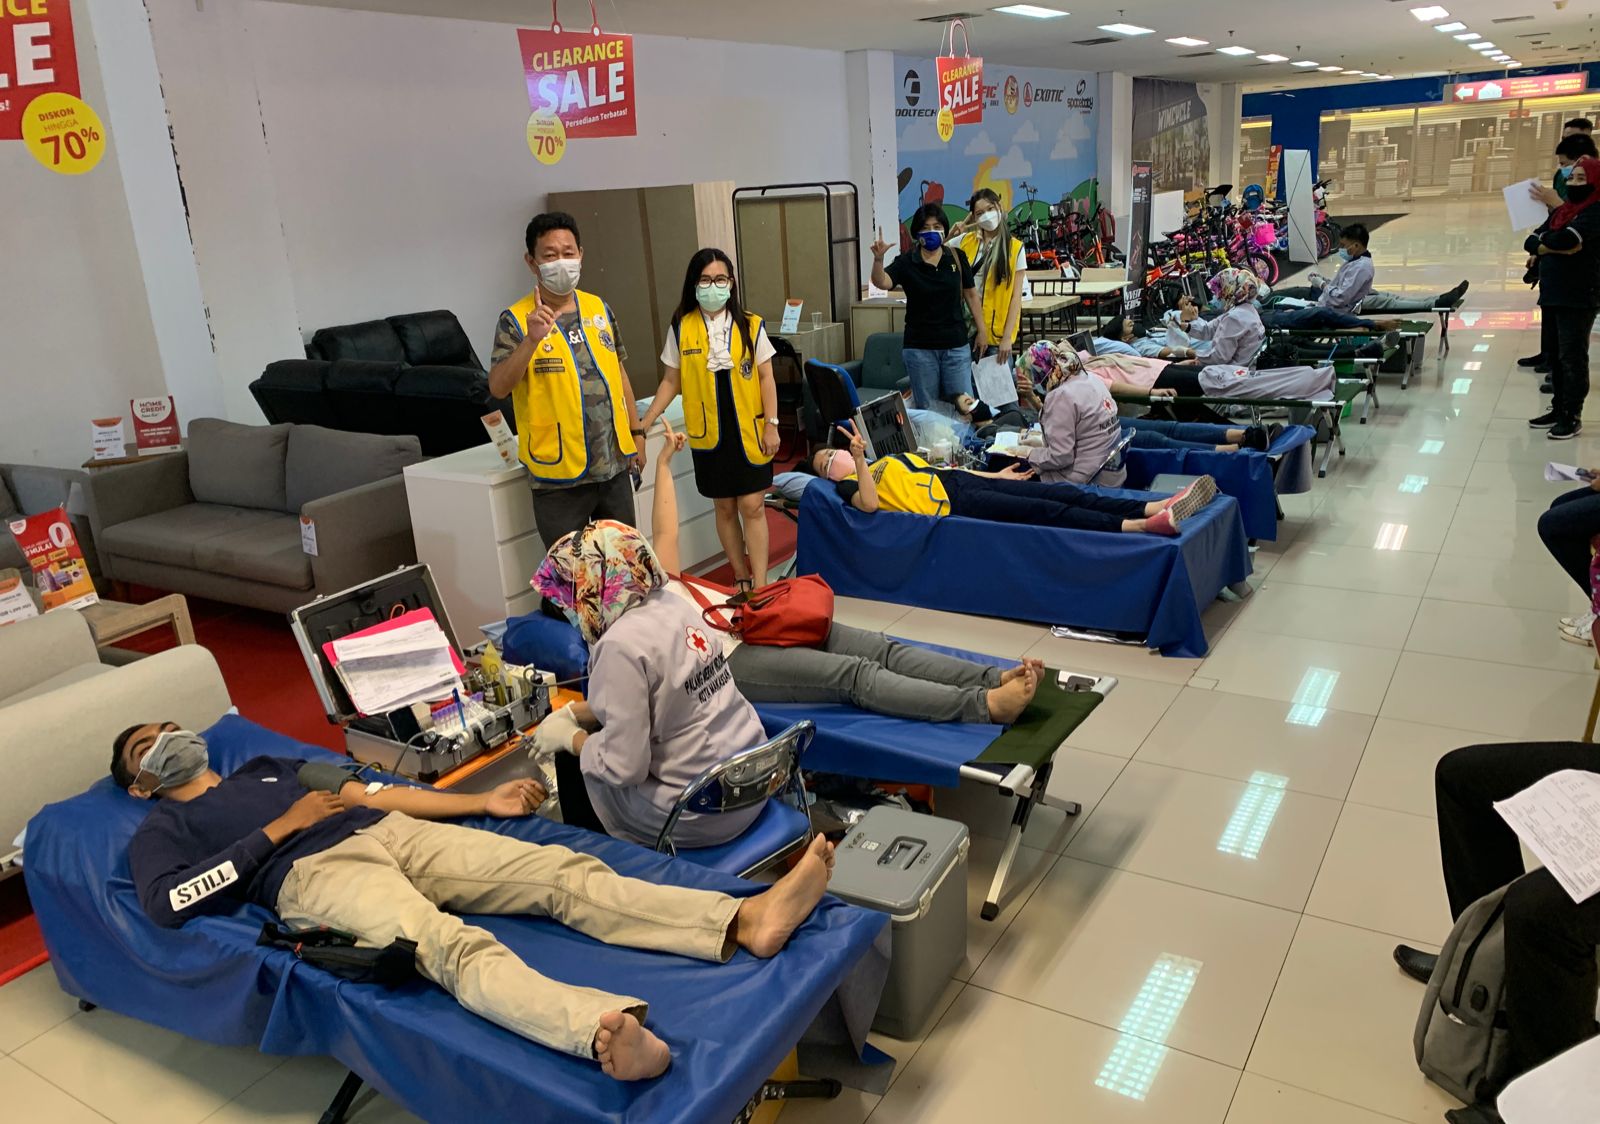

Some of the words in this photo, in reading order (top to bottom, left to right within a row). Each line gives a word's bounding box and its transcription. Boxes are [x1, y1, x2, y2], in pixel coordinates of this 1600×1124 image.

[532, 40, 624, 72] CLEARANCE
[942, 61, 980, 83] CLEARANCE
[538, 62, 625, 116] SALE
[944, 75, 979, 112] SALE
[1034, 88, 1064, 102] EXOTIC
[38, 107, 75, 122] DISKON
[565, 115, 600, 129] Persediaan
[600, 108, 628, 121] Terbatas!
[43, 118, 80, 133] HINGGA
[40, 126, 100, 165] 70%
[533, 135, 564, 156] 70%
[140, 405, 166, 414] CREDIT
[30, 542, 53, 556] MULAI
[177, 868, 231, 904] STILL
